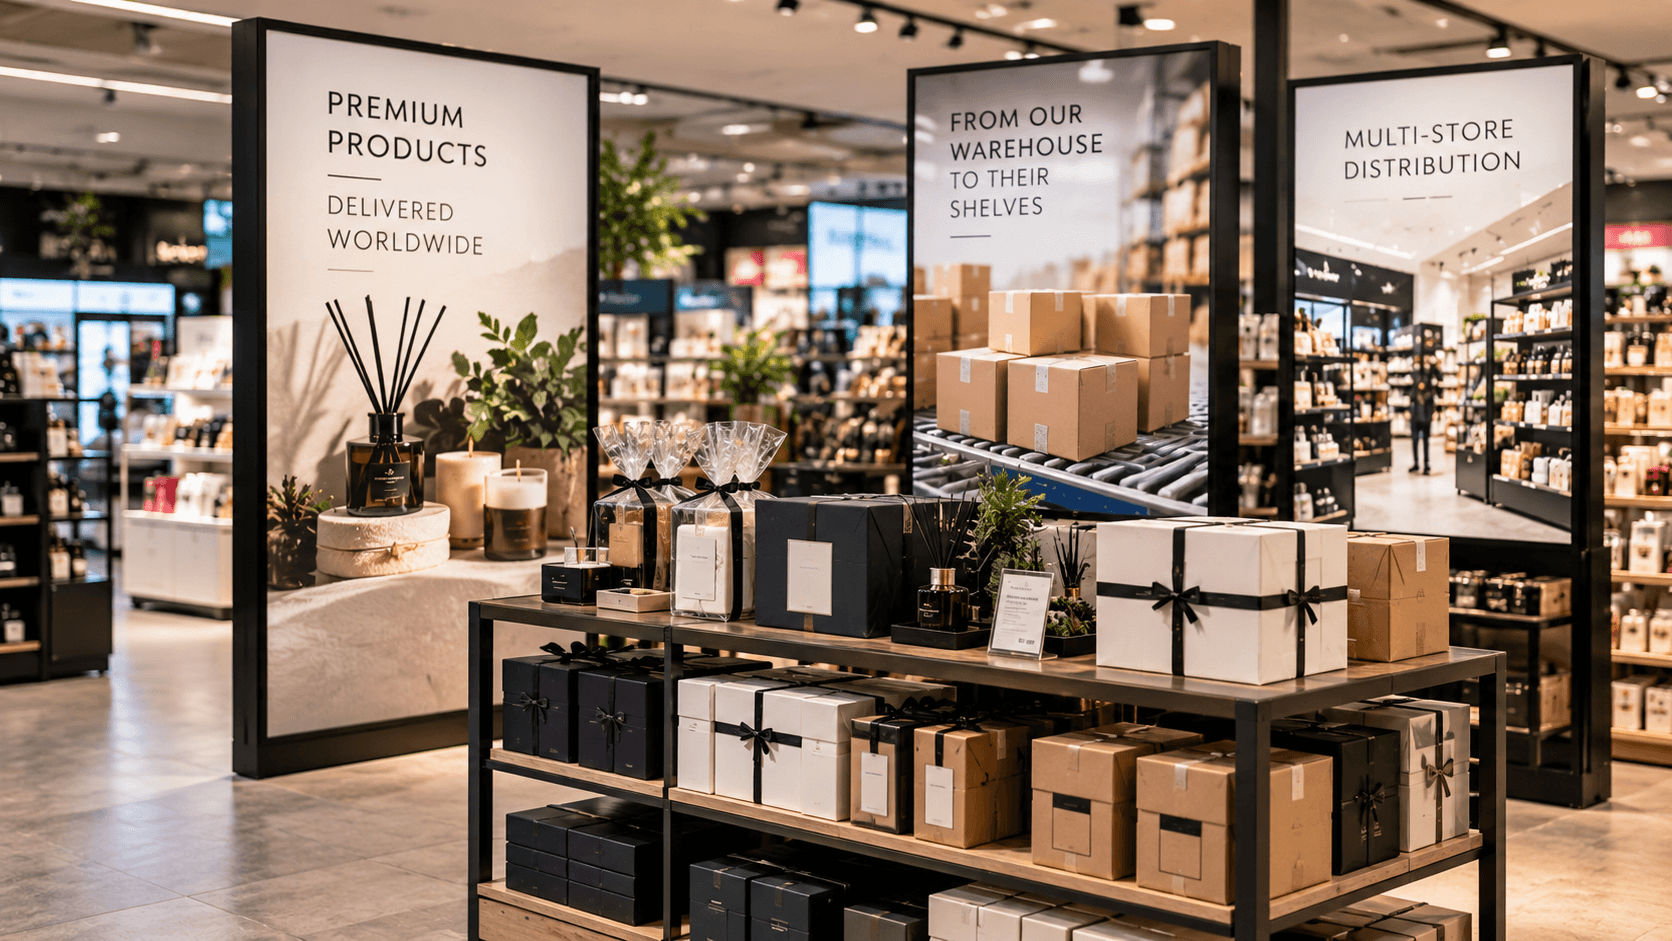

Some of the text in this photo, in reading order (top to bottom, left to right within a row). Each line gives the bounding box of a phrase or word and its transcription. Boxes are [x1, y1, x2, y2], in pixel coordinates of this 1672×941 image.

[328, 90, 464, 129] PREMIUM
[950, 103, 1083, 133] FROM OUR
[328, 129, 488, 168] PRODUCTS
[949, 132, 1103, 162] WAREHOUSE
[1344, 118, 1514, 150] MULTI-STORE
[949, 167, 1049, 190] TO THEIR
[1344, 150, 1521, 180] DISTRIBUTION
[328, 194, 454, 222] DELIVERED
[950, 196, 1043, 219] SHELVES
[327, 228, 483, 256] WORLDWIDE
